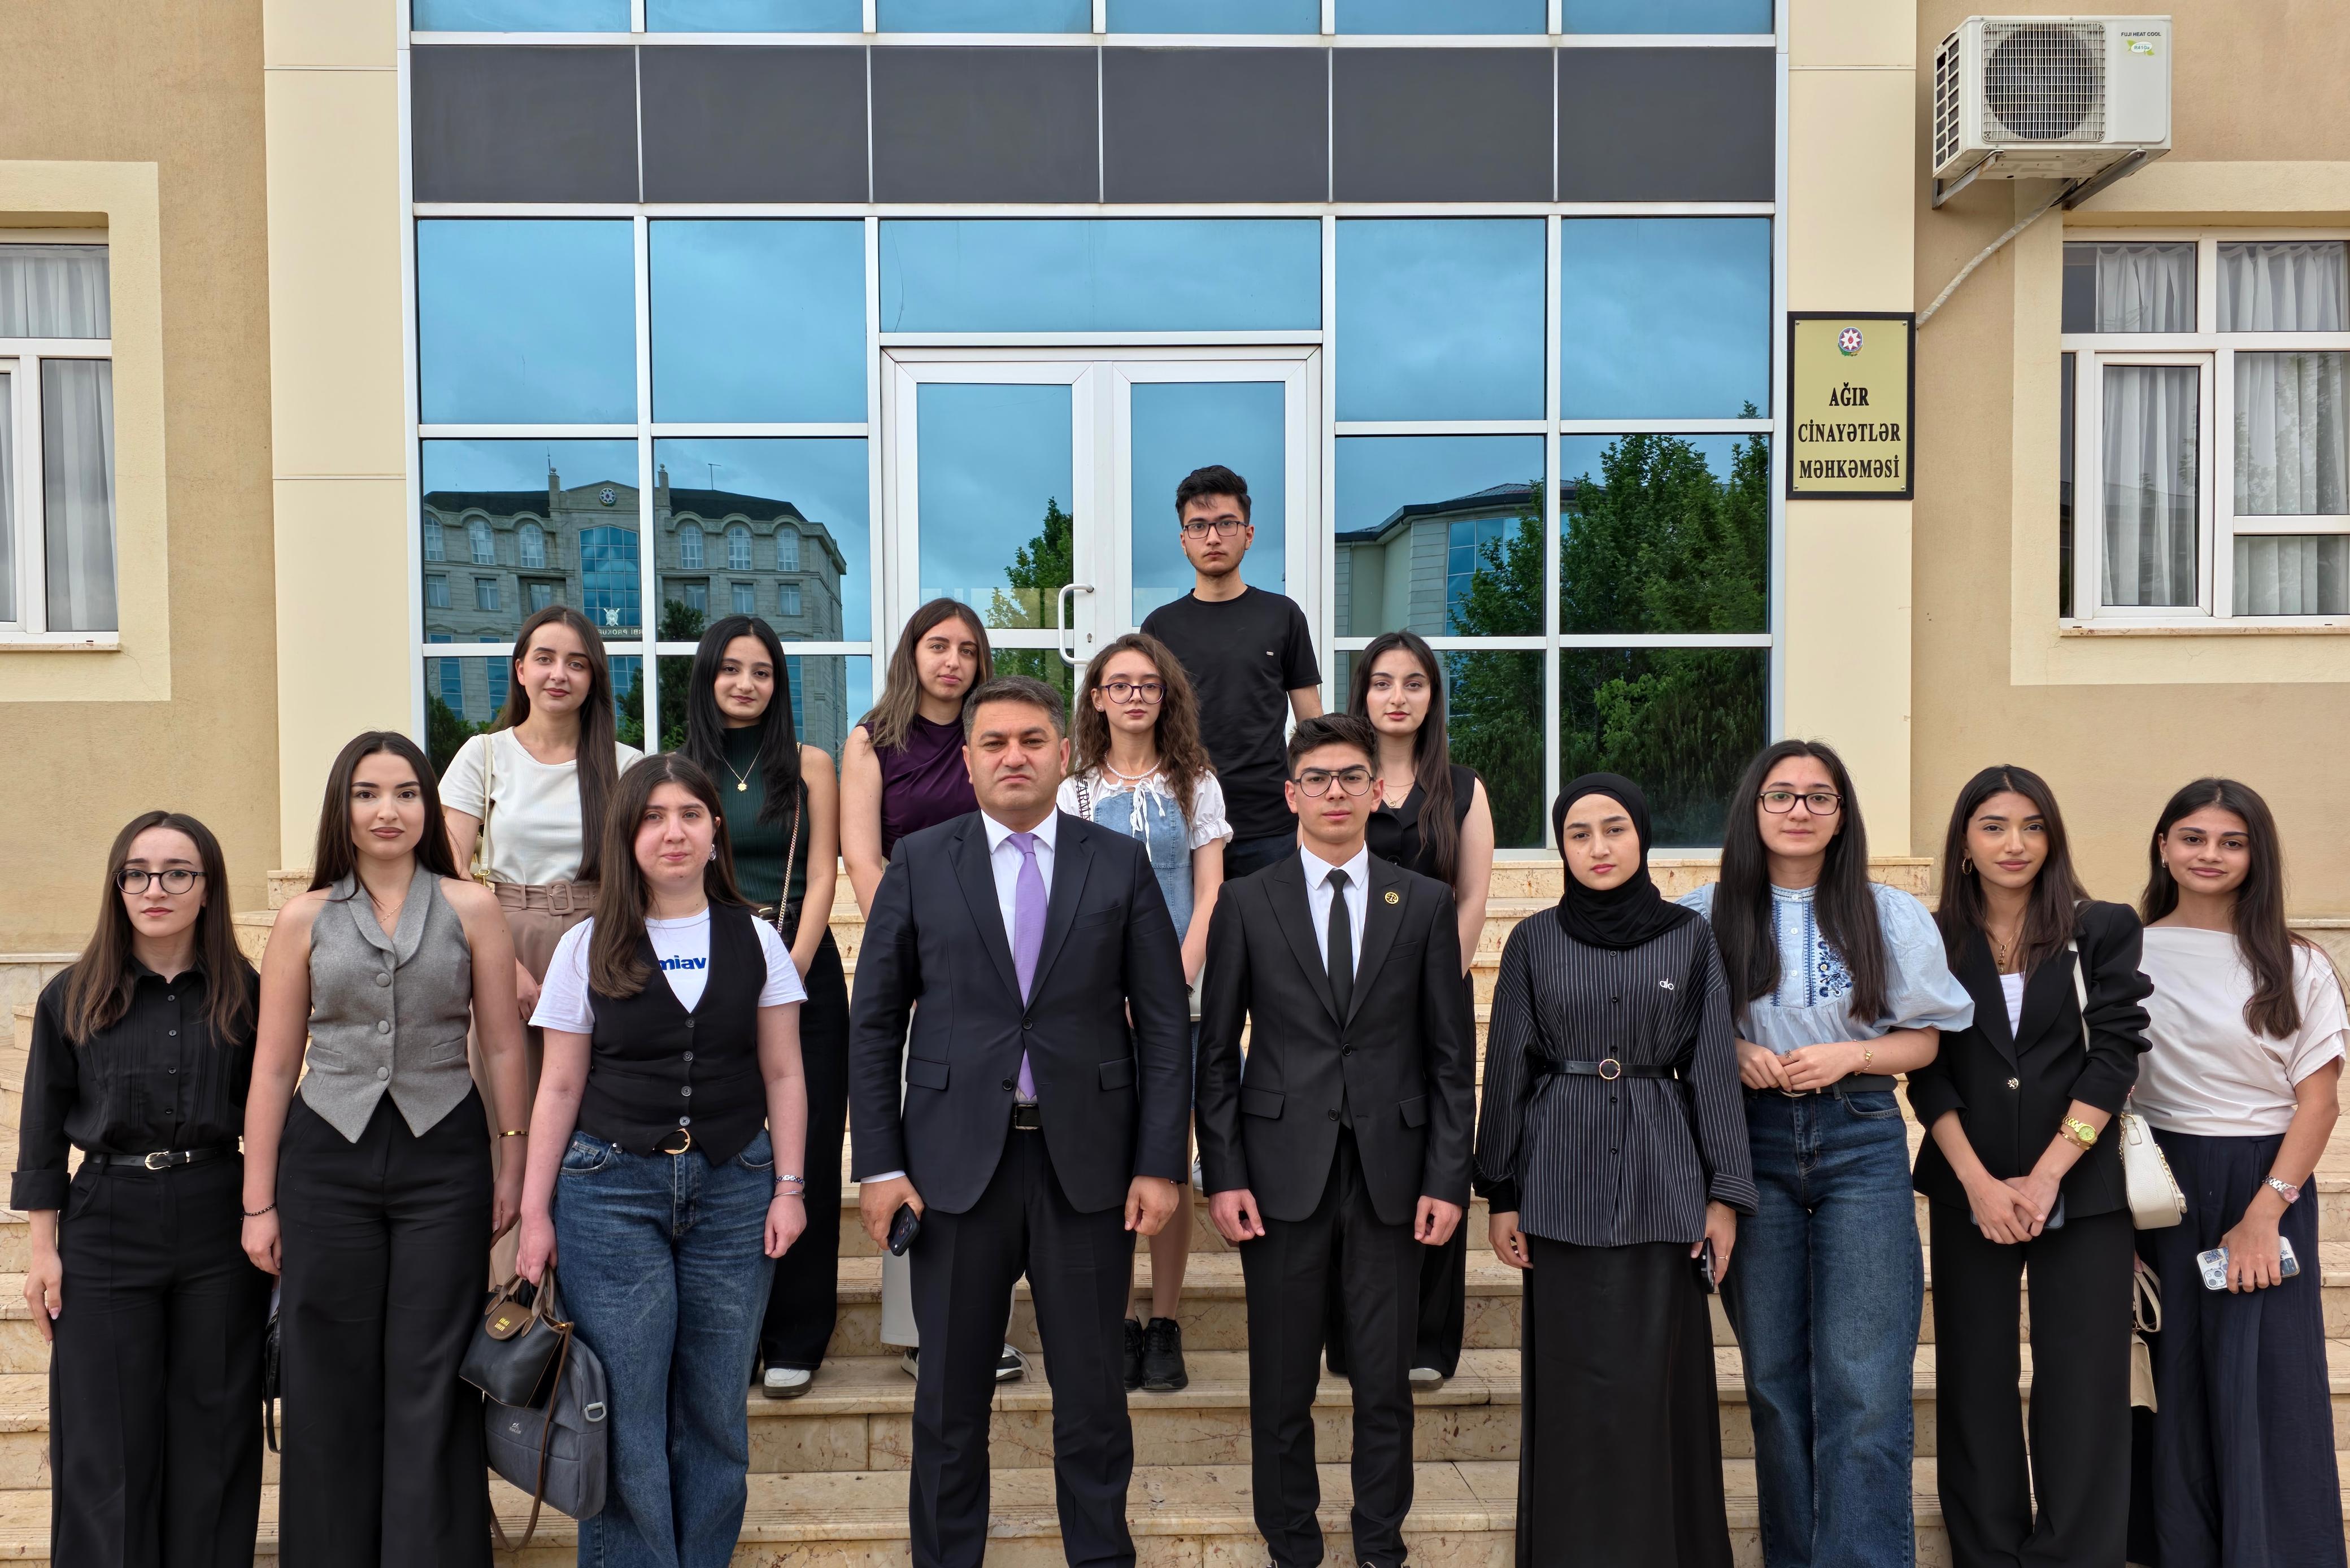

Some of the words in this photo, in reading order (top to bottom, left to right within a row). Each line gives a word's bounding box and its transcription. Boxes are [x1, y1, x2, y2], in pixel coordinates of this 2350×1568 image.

[1829, 382, 1869, 406] AĞIR
[1798, 419, 1901, 442] CİNAYƏTLƏR
[1799, 454, 1900, 478] MƏHKƏMƏSİ
[1659, 978, 1674, 990] alo
